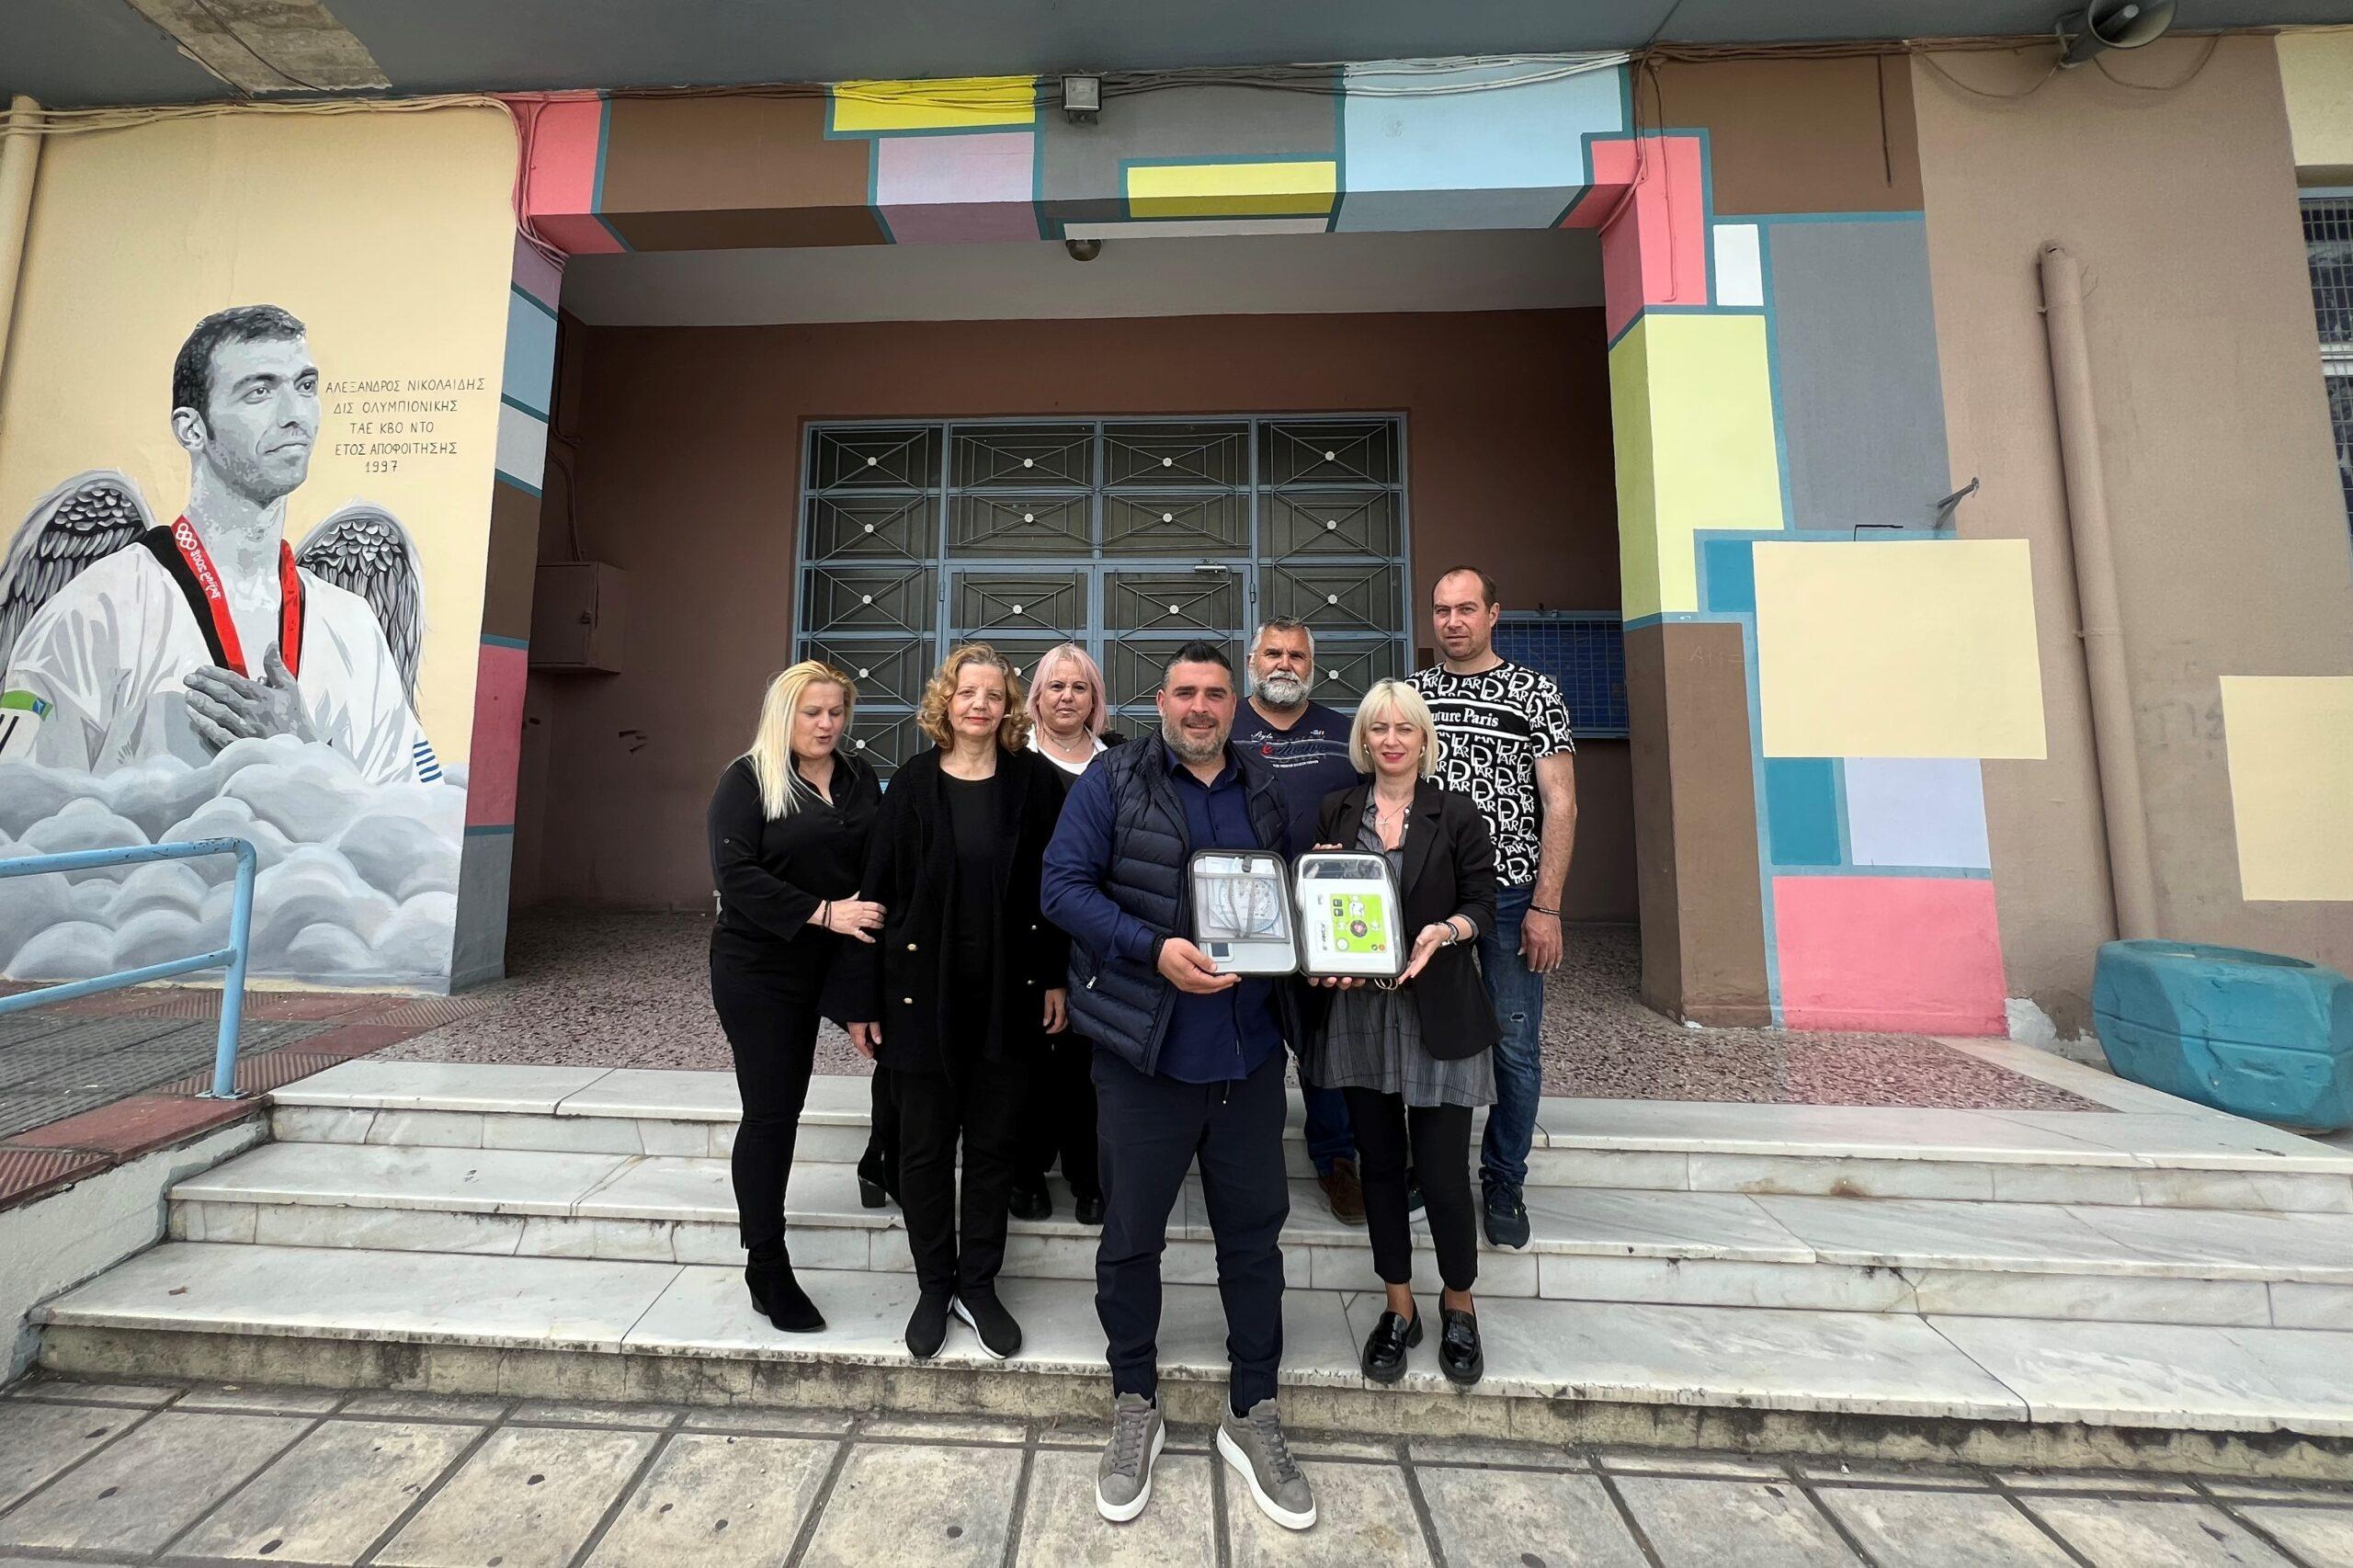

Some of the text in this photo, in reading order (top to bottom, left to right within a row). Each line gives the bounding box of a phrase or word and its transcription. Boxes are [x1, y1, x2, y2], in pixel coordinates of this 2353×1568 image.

[325, 378, 486, 393] ΑΛΕΞΑΝΔΡΟΣ ΝΙΚΟΛΑΙΔΗΣ
[333, 400, 459, 415] ΔΙΣ ΟΛΥΜΠΙΟΝΙΚΗΣ
[350, 422, 373, 435] ΤΑΕ
[410, 421, 435, 434] ΝΤΟ
[335, 441, 459, 456] ΕΤΟΣ ΑΠΟΦΟΙΤΗΣΗΣ
[365, 460, 398, 472] 1997
[1430, 708, 1499, 728] uture Paris
